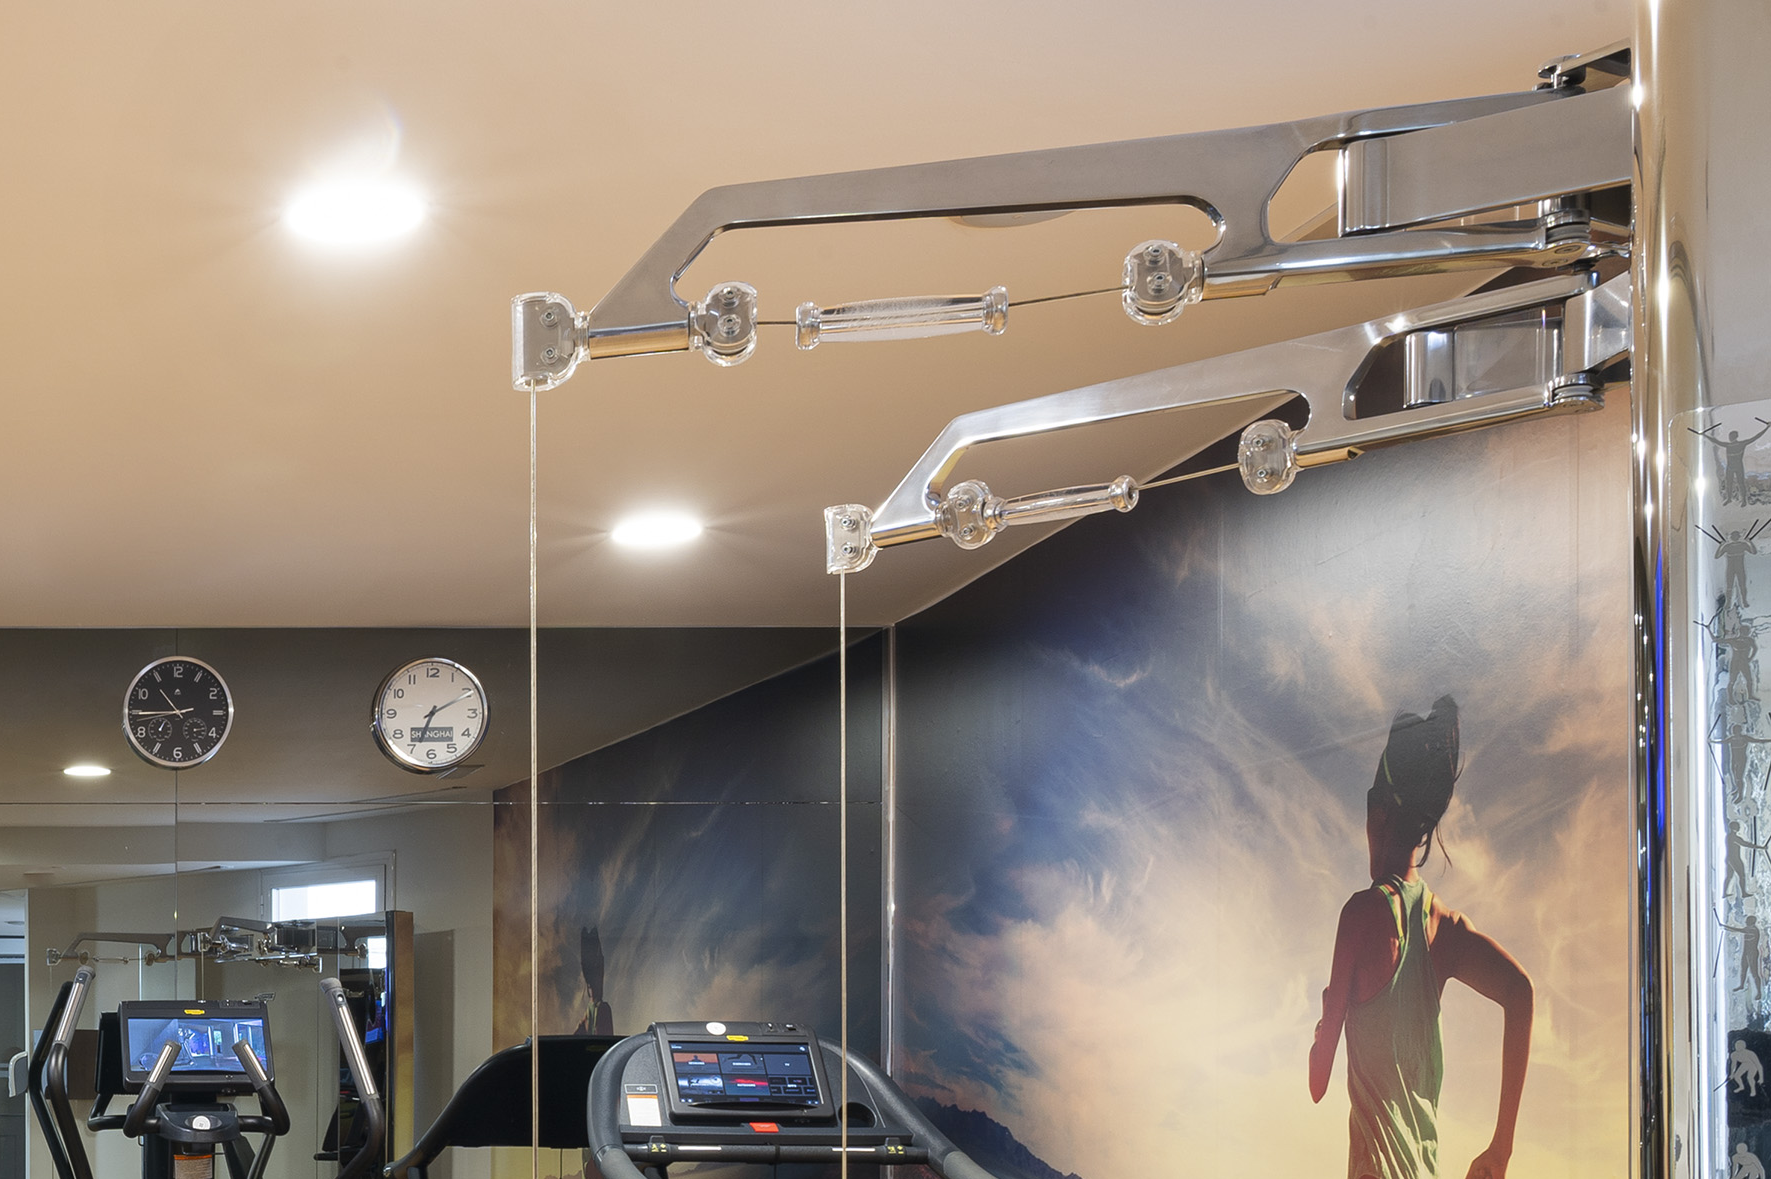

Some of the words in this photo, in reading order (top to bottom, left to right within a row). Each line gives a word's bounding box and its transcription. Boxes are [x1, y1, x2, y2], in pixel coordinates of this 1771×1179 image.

[174, 667, 183, 677] 12
[427, 668, 439, 678] 12
[409, 675, 416, 685] 11
[452, 673, 454, 682] 1
[138, 688, 148, 700] 10
[209, 688, 217, 699] 2
[394, 689, 404, 699] 10
[386, 709, 397, 719] 9
[467, 709, 477, 719] 3
[137, 726, 145, 738] 8
[208, 727, 216, 738] 4
[393, 729, 404, 739] 8
[411, 730, 452, 738] SHNGHAI
[461, 728, 471, 738] 4
[173, 747, 182, 758] 6
[407, 744, 416, 754] 7
[446, 744, 457, 753] 5
[426, 749, 436, 759] 6
